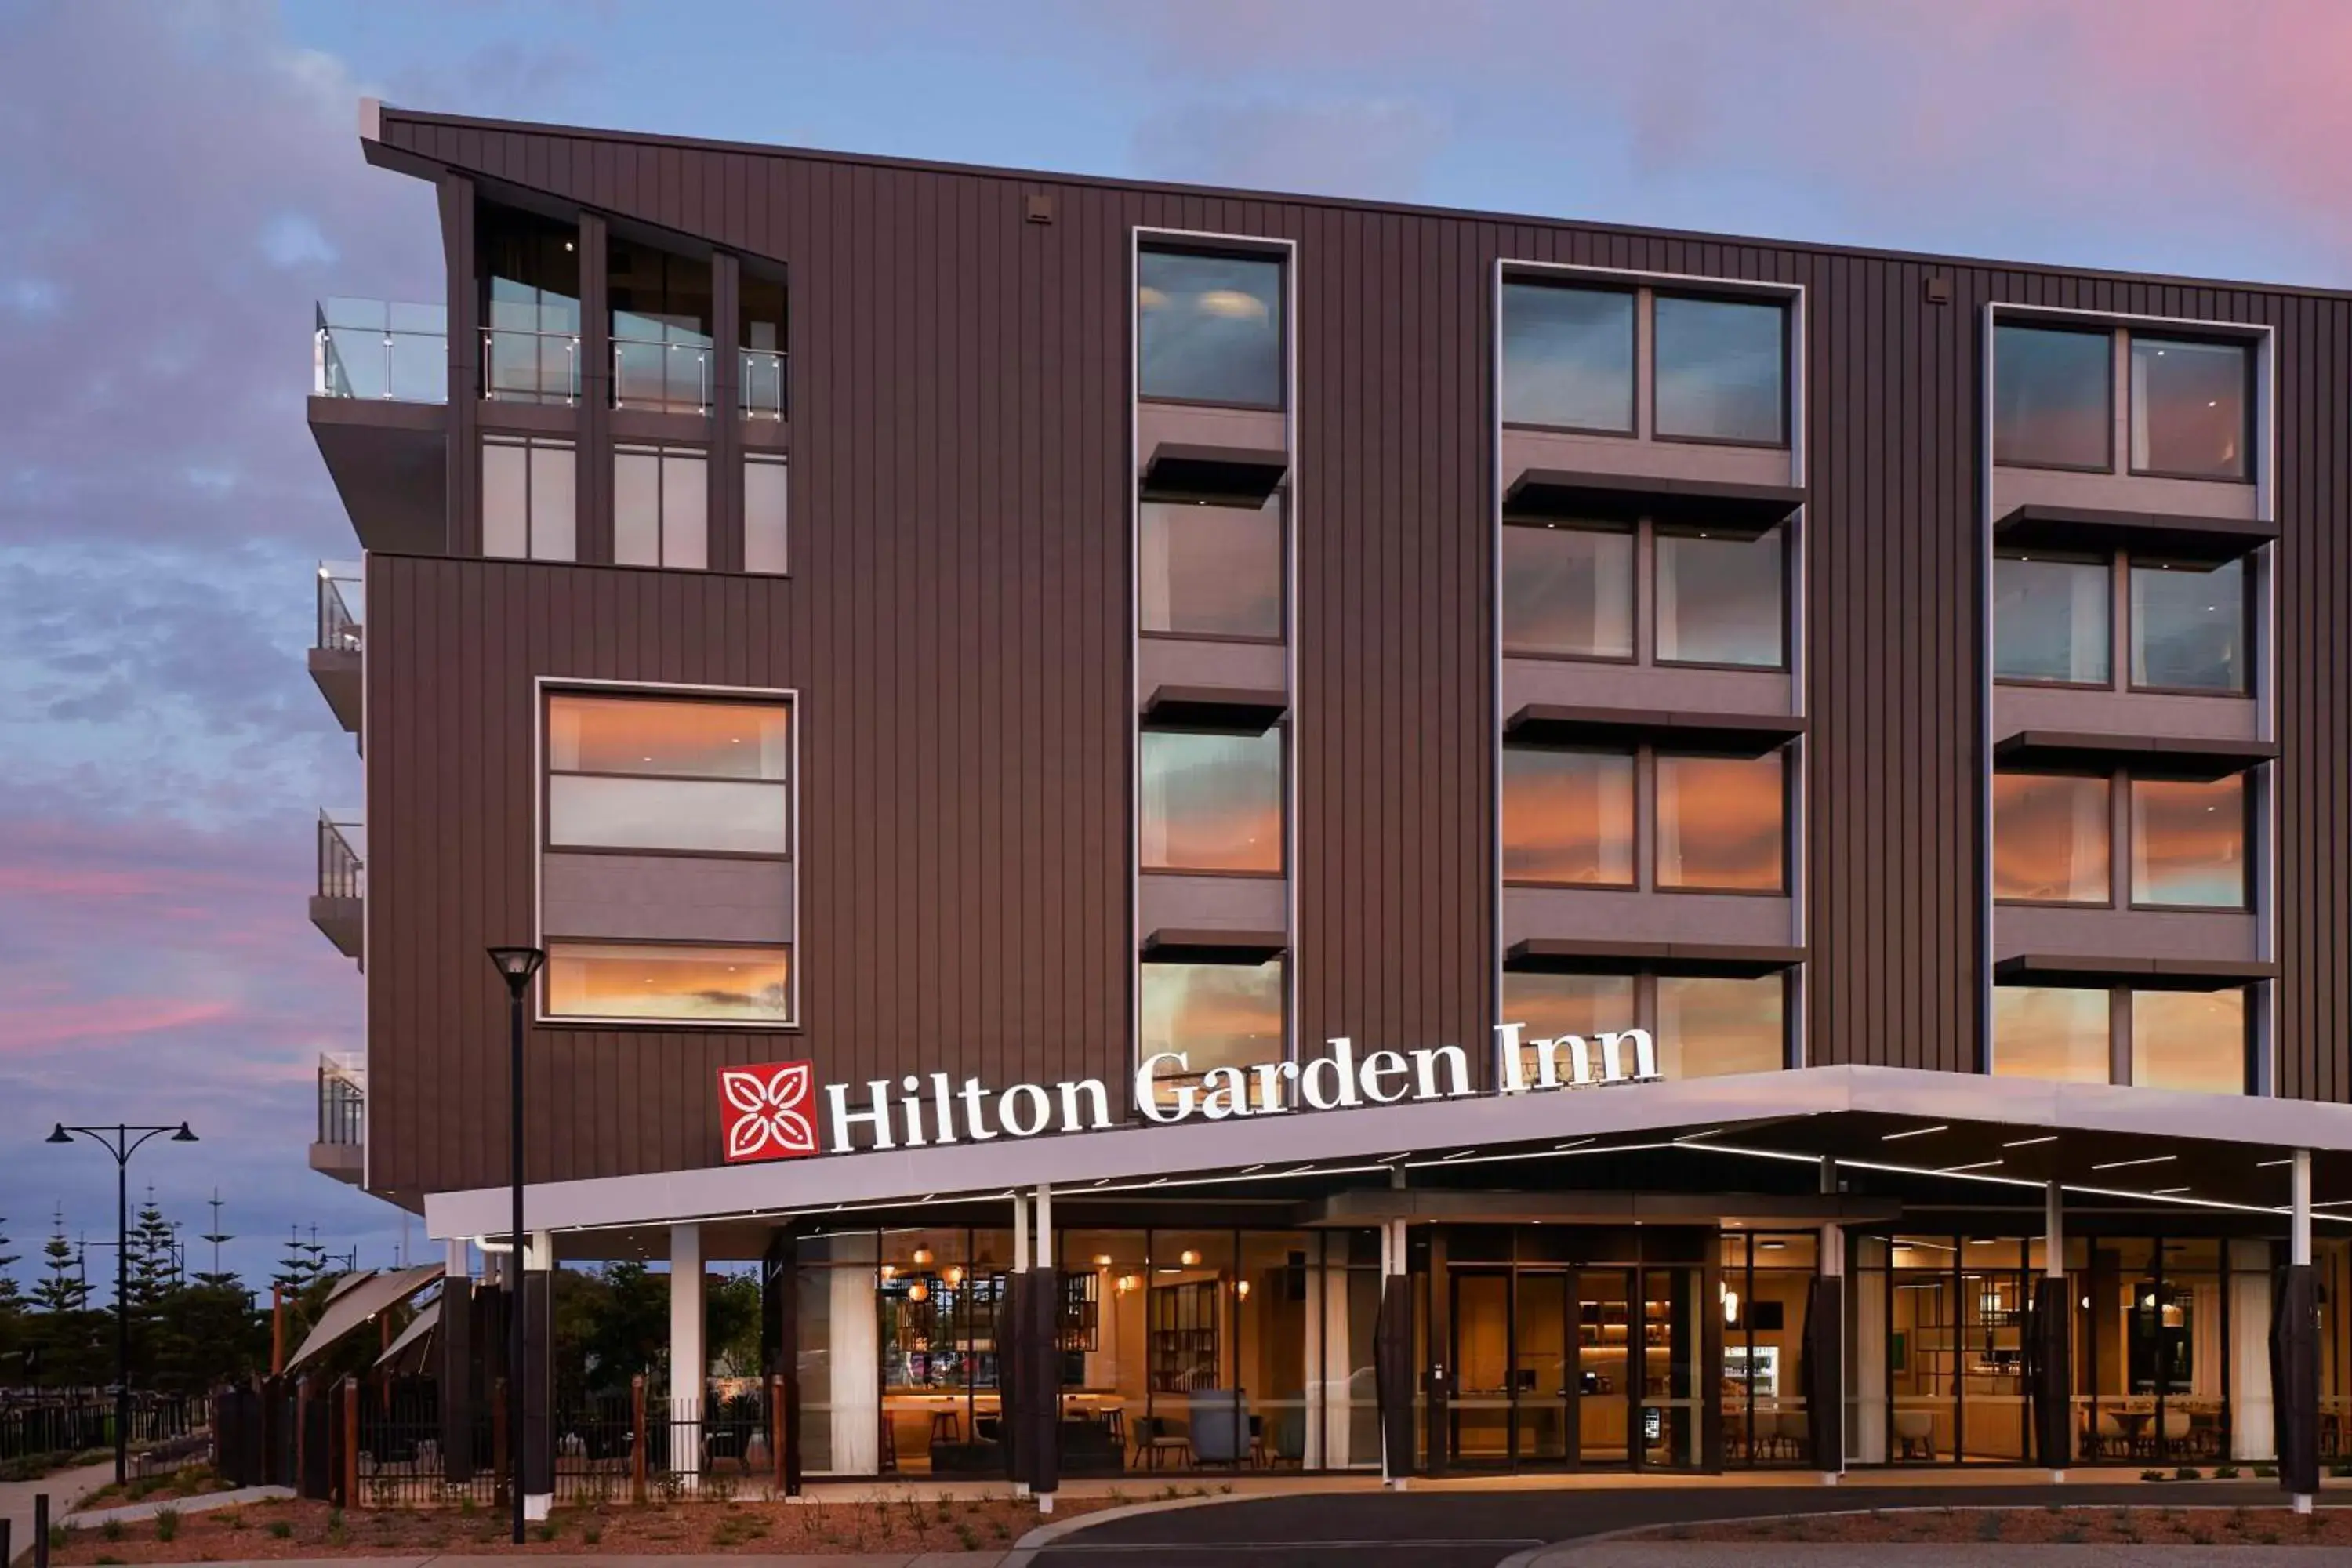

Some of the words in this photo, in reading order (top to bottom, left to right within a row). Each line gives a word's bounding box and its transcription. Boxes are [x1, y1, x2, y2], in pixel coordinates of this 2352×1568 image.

[825, 1073, 1113, 1153] Hilton
[1135, 1037, 1475, 1123] Garden
[1494, 1022, 1663, 1093] Inn
